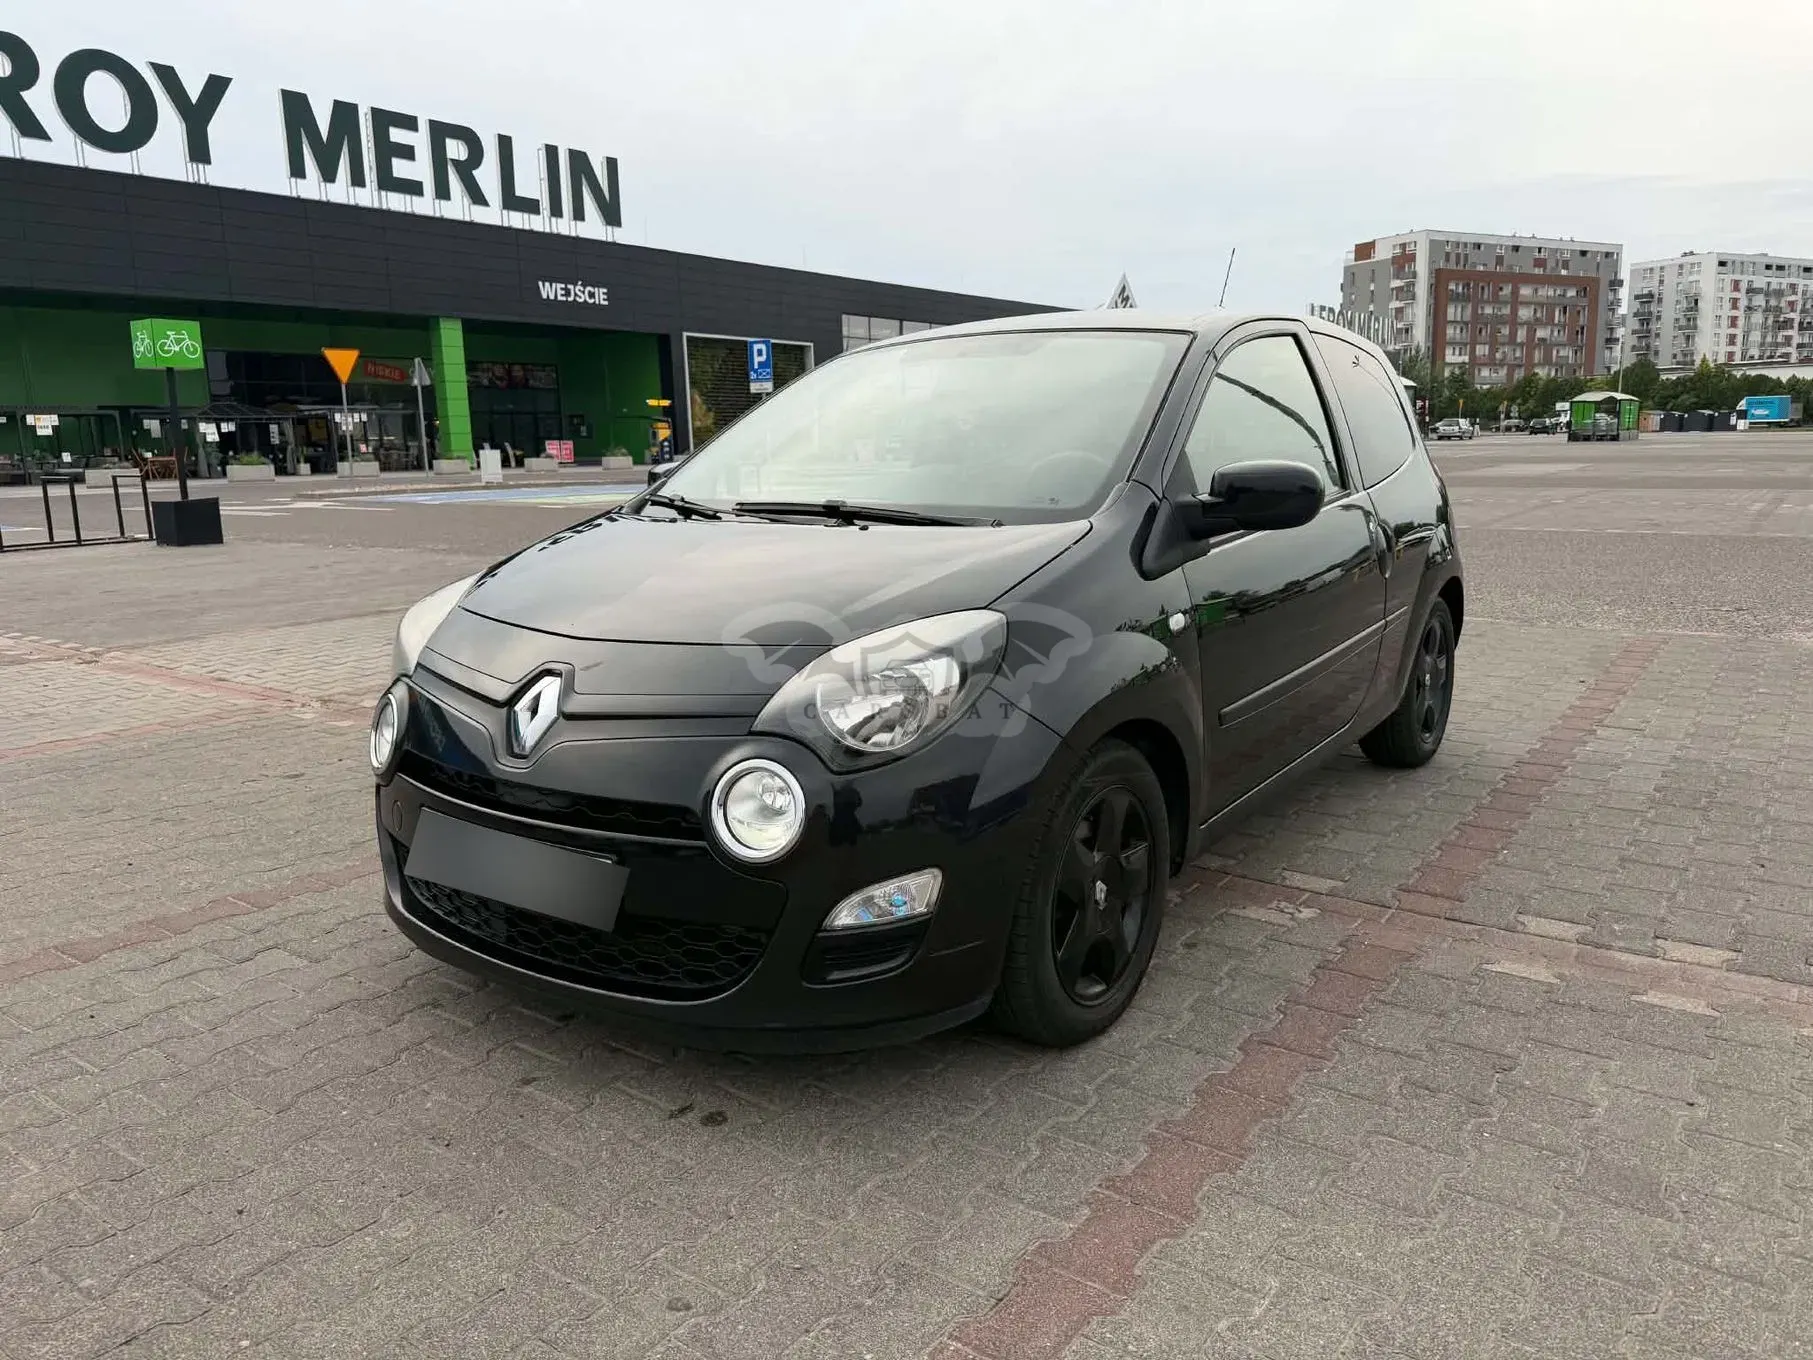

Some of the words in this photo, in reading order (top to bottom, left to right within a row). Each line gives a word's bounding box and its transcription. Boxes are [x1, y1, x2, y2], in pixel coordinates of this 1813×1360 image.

[280, 87, 622, 228] MERLIN
[537, 280, 609, 306] WEJŚCIE
[753, 343, 767, 369] P
